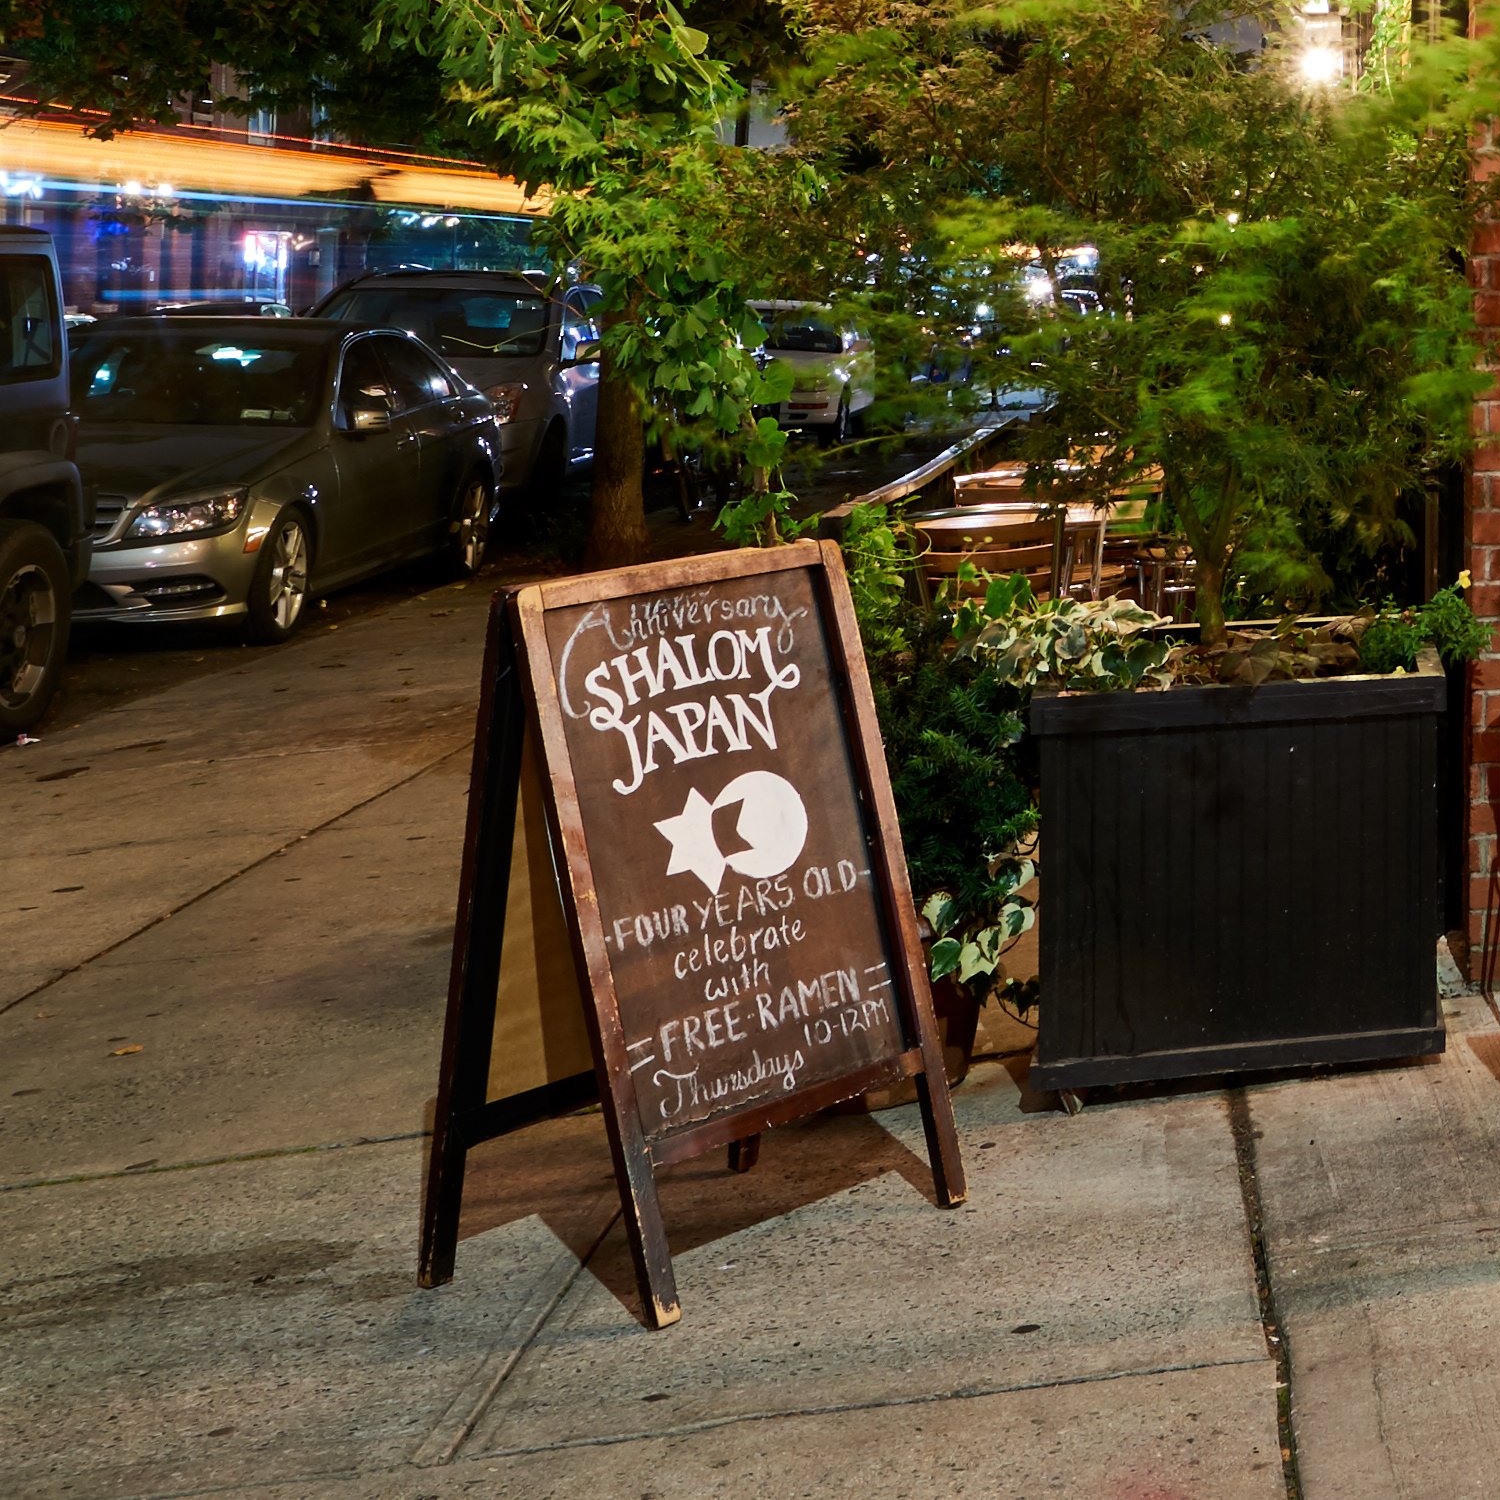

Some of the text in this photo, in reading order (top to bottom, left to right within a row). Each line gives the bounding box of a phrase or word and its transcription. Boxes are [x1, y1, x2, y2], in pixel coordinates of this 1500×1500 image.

[560, 593, 808, 719] Anniversary
[584, 625, 802, 731] SHALOM
[612, 693, 779, 795] JAPAN
[693, 873, 796, 931] YEARS
[673, 914, 807, 980] celebrate
[704, 957, 771, 1001] with
[652, 1048, 806, 1119] Thursdays
